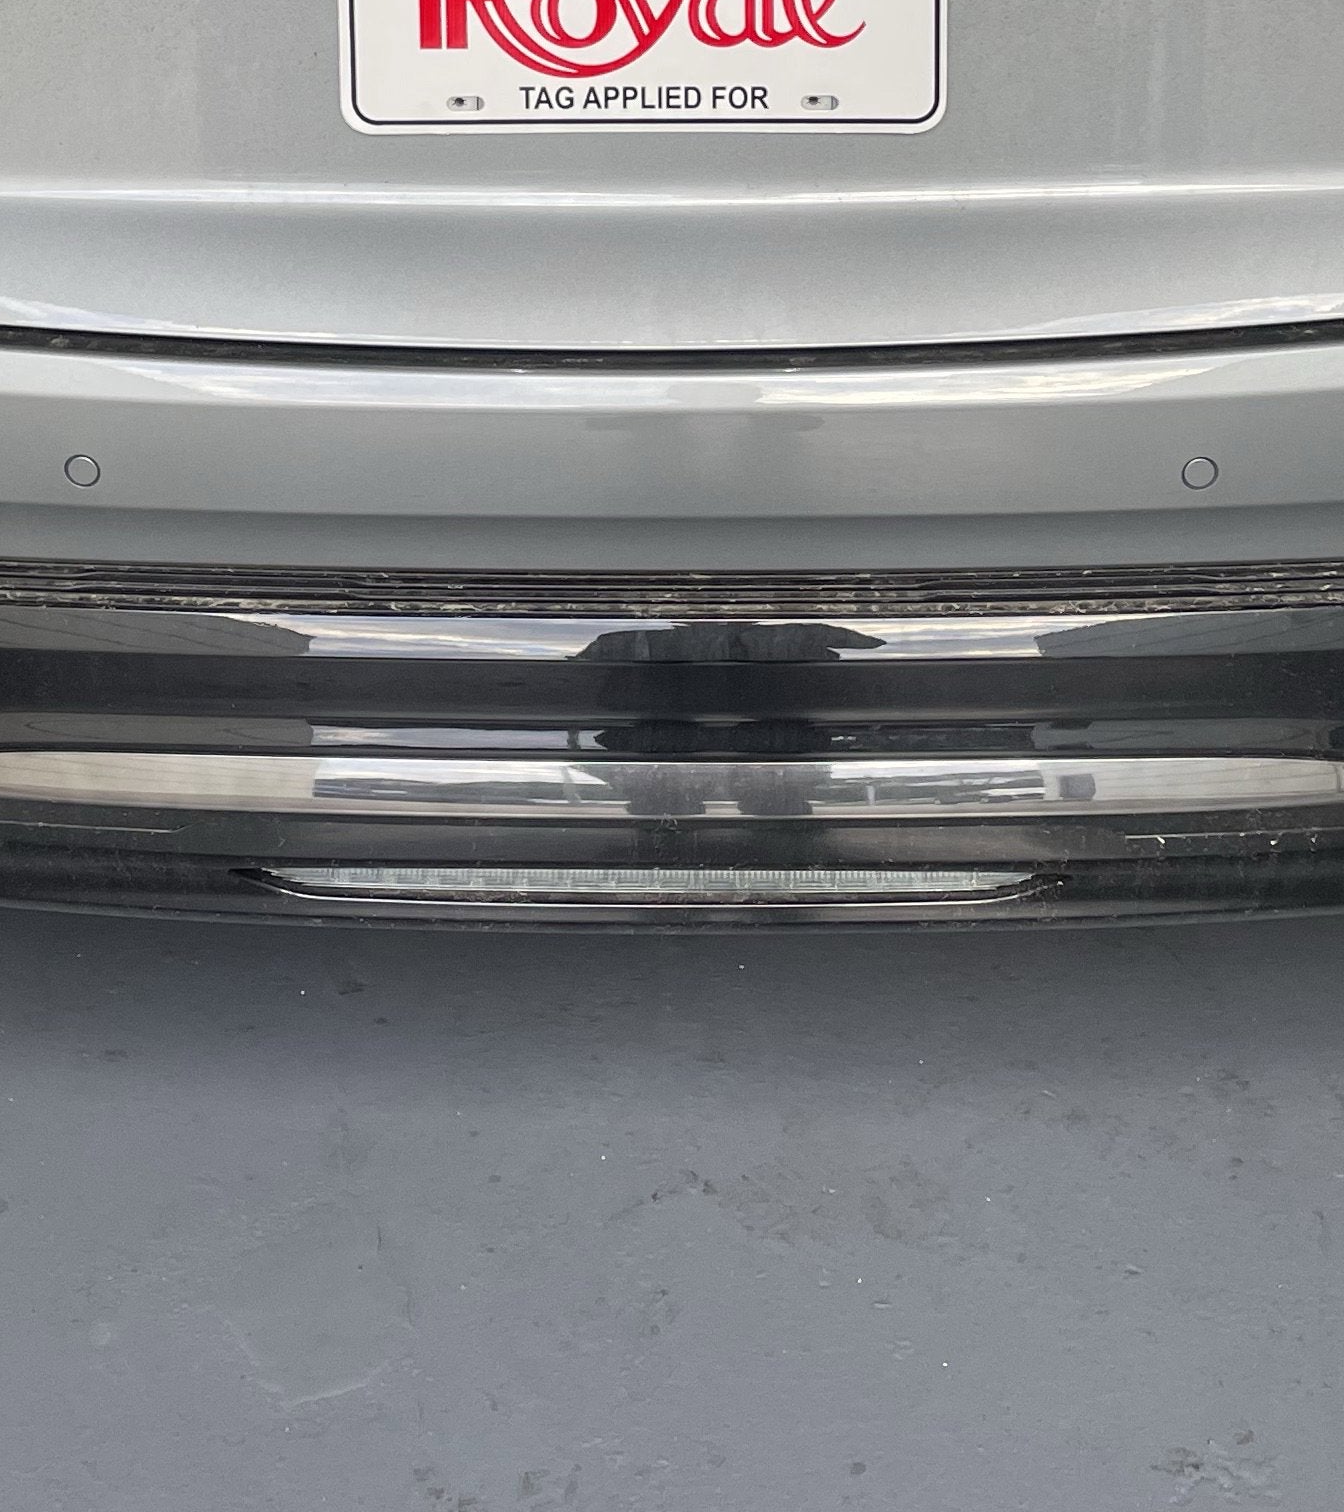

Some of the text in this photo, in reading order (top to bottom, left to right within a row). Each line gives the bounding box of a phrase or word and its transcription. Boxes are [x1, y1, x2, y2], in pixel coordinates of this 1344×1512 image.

[519, 86, 770, 110] TAG APPLIED FOR
